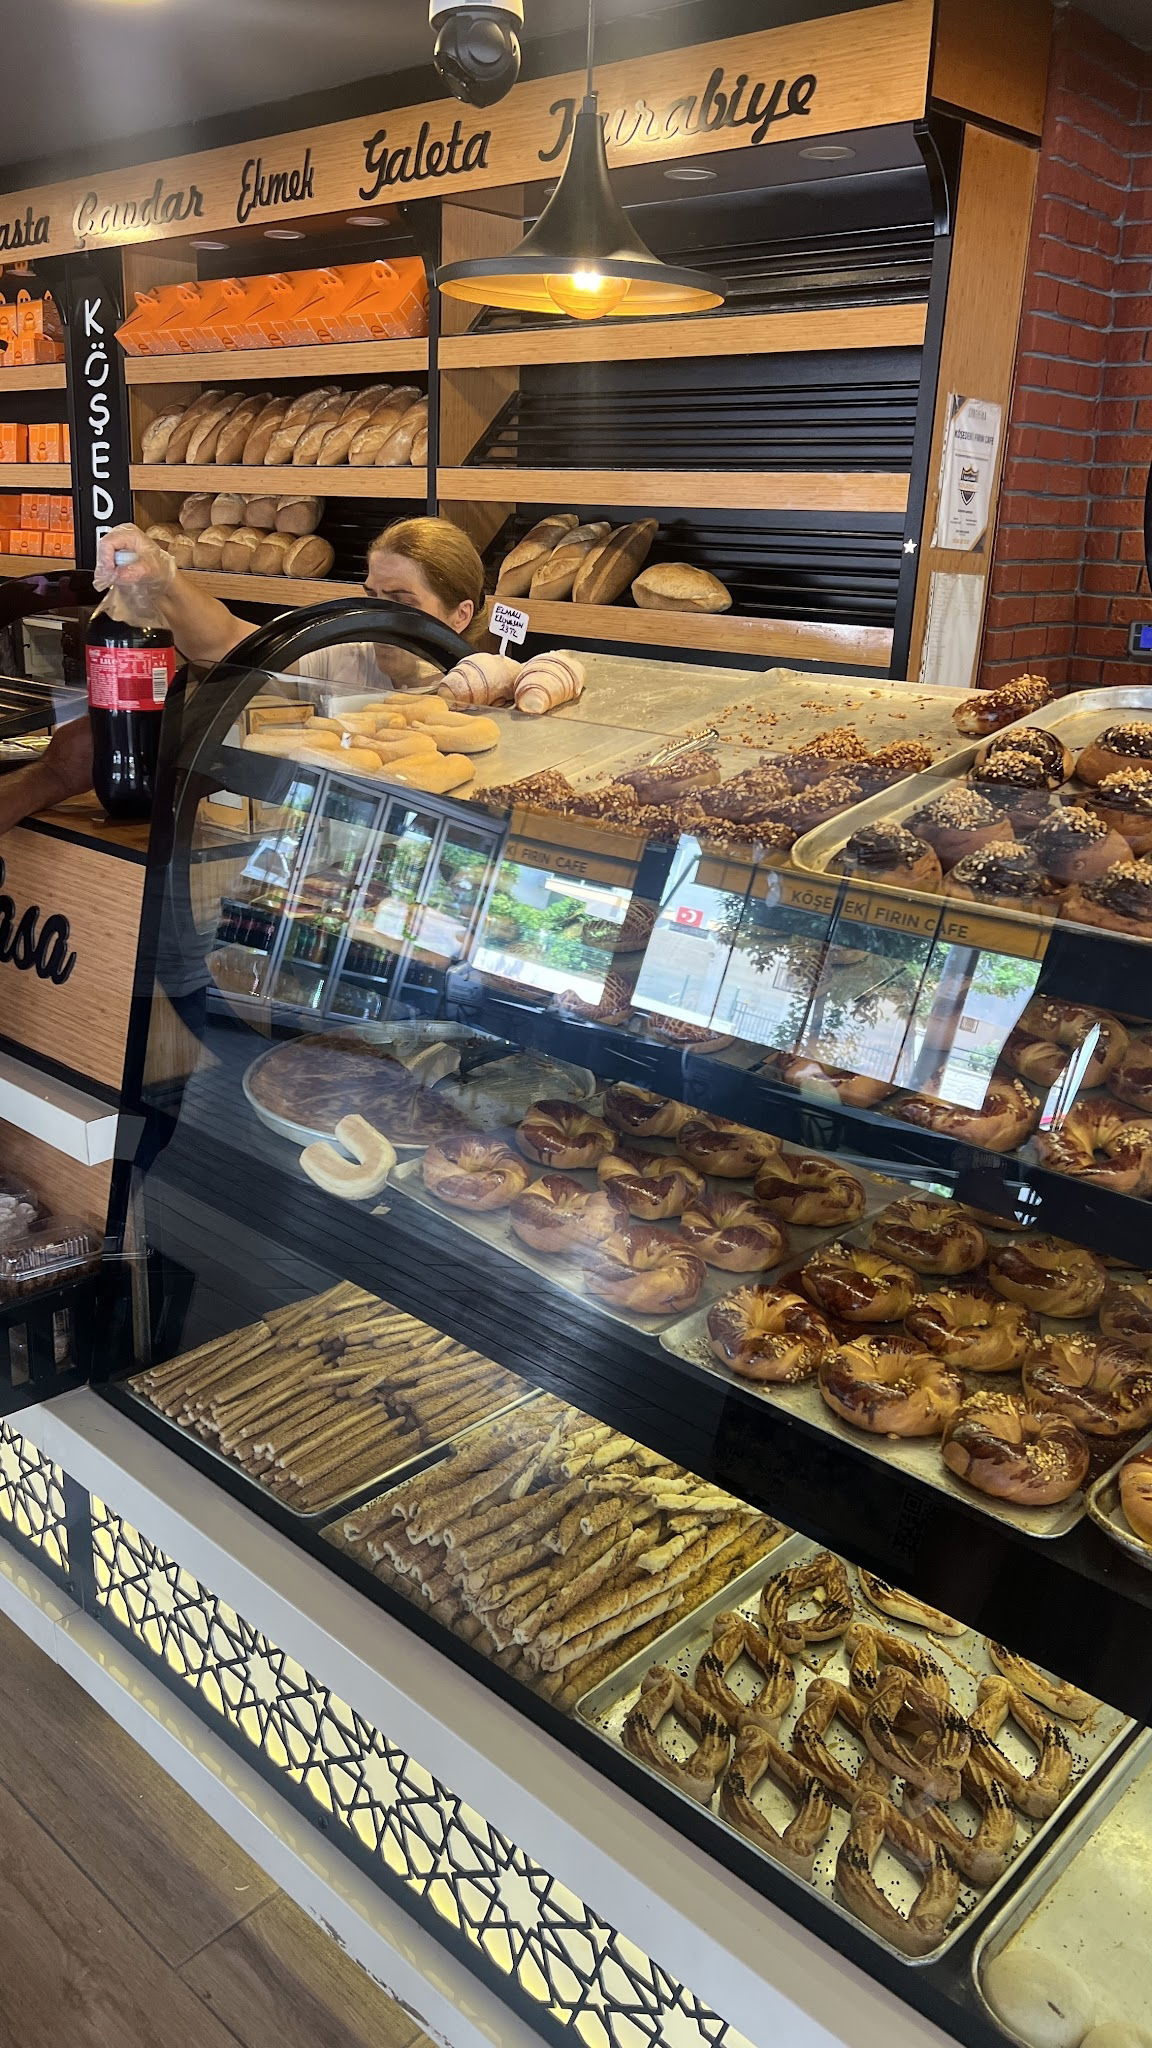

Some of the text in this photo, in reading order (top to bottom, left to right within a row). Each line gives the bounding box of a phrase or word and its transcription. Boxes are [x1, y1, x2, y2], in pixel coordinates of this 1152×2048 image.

[0, 206, 50, 250] asta
[236, 148, 315, 224] Ekmek
[359, 119, 493, 201] Galeta
[84, 297, 115, 558] KÖŞED
[0, 855, 78, 985] asa
[555, 856, 589, 874] CAFE
[874, 907, 921, 929] FIRIN
